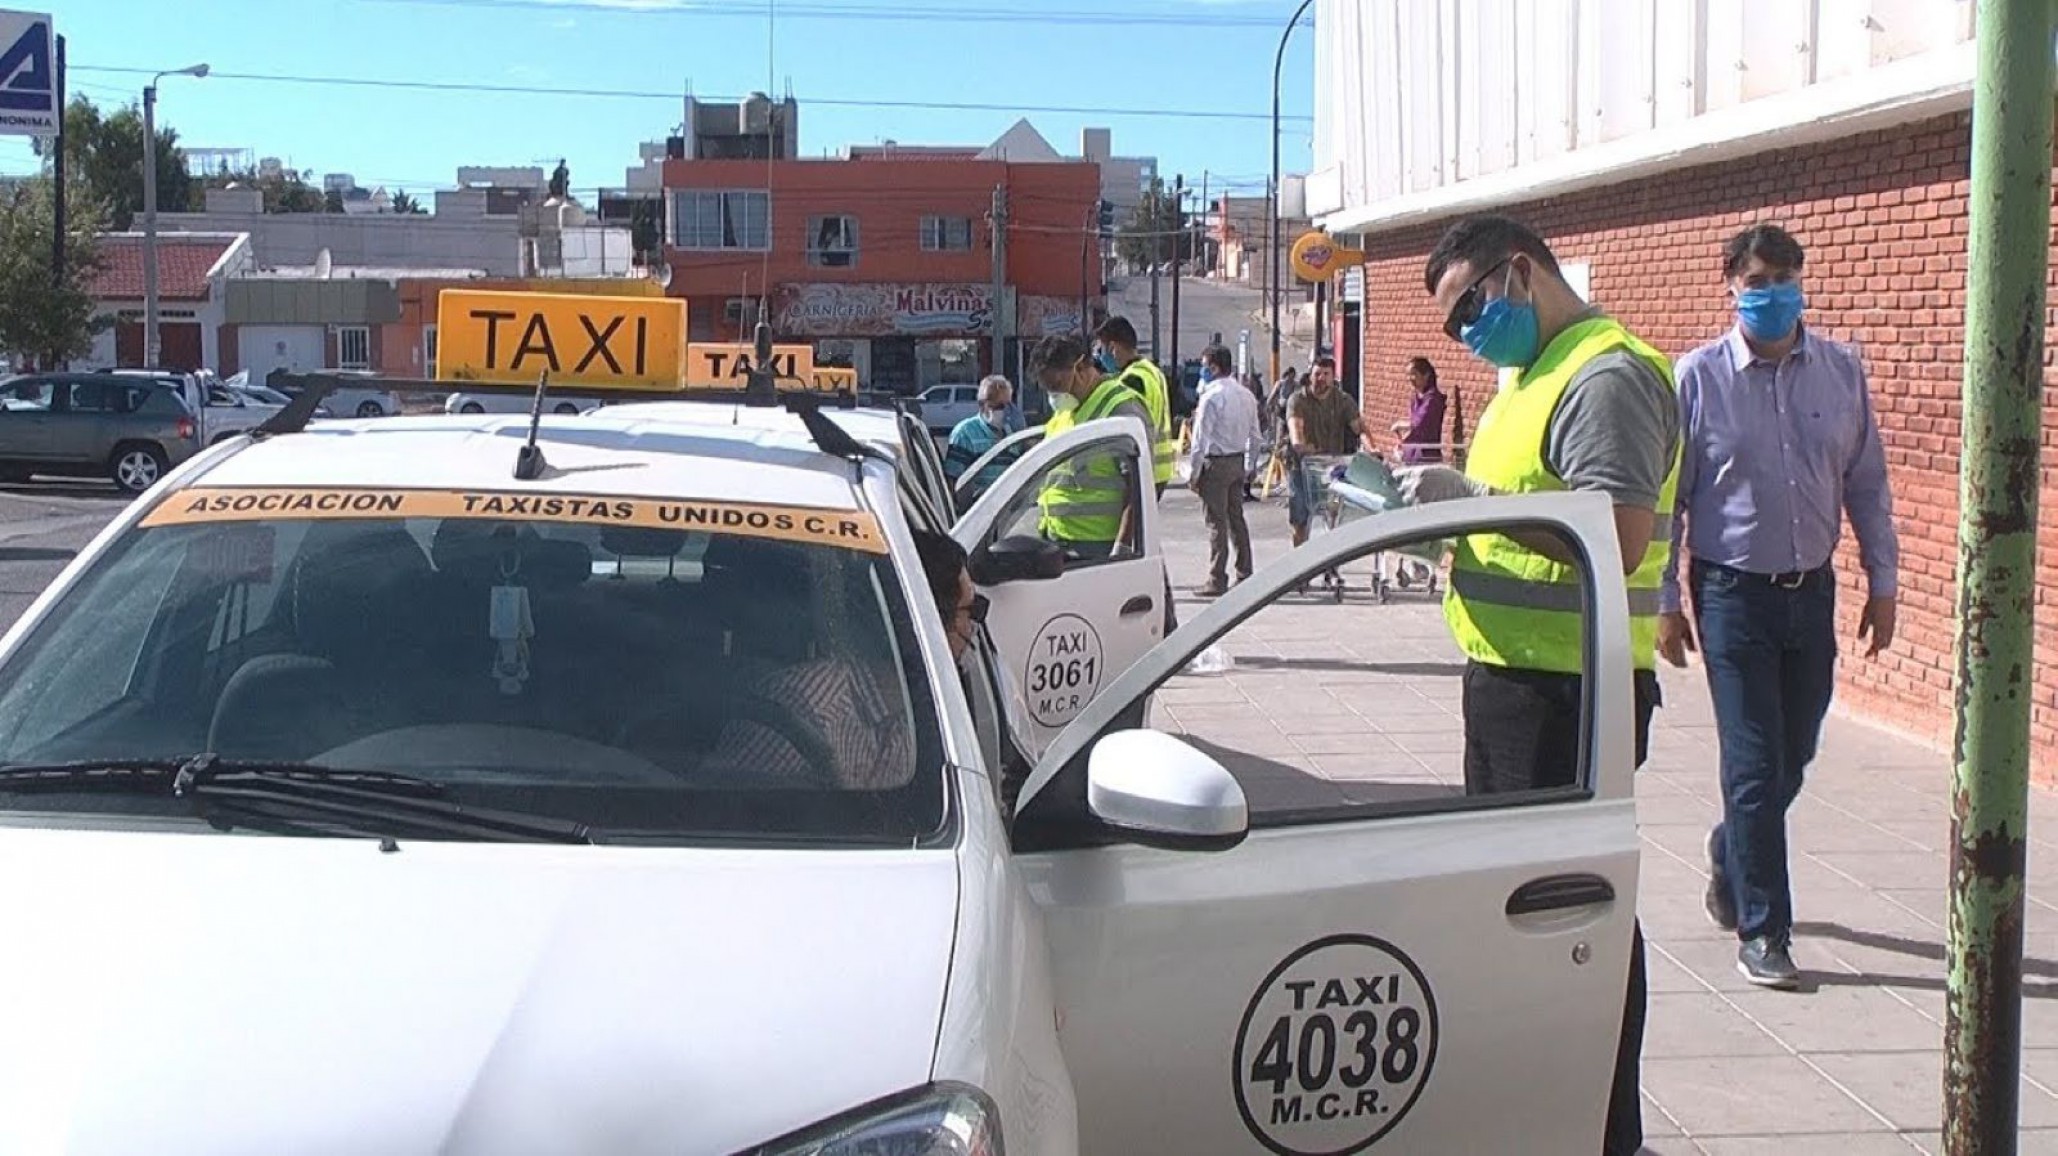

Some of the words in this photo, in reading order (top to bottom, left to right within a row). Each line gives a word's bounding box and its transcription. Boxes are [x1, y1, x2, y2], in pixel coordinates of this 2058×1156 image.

[895, 289, 994, 315] Malvinas
[469, 309, 647, 376] TAXI
[185, 493, 405, 513] ASOCIACION
[462, 495, 634, 519] TAXISTAS
[658, 506, 794, 531] UNIDOS
[804, 518, 870, 540] C.R.
[1046, 630, 1087, 657] TAXI
[1031, 656, 1096, 694] 3061
[1284, 974, 1400, 1011] TAXI
[1251, 1006, 1421, 1094] 4038
[1271, 1088, 1390, 1125] M.C.R.
